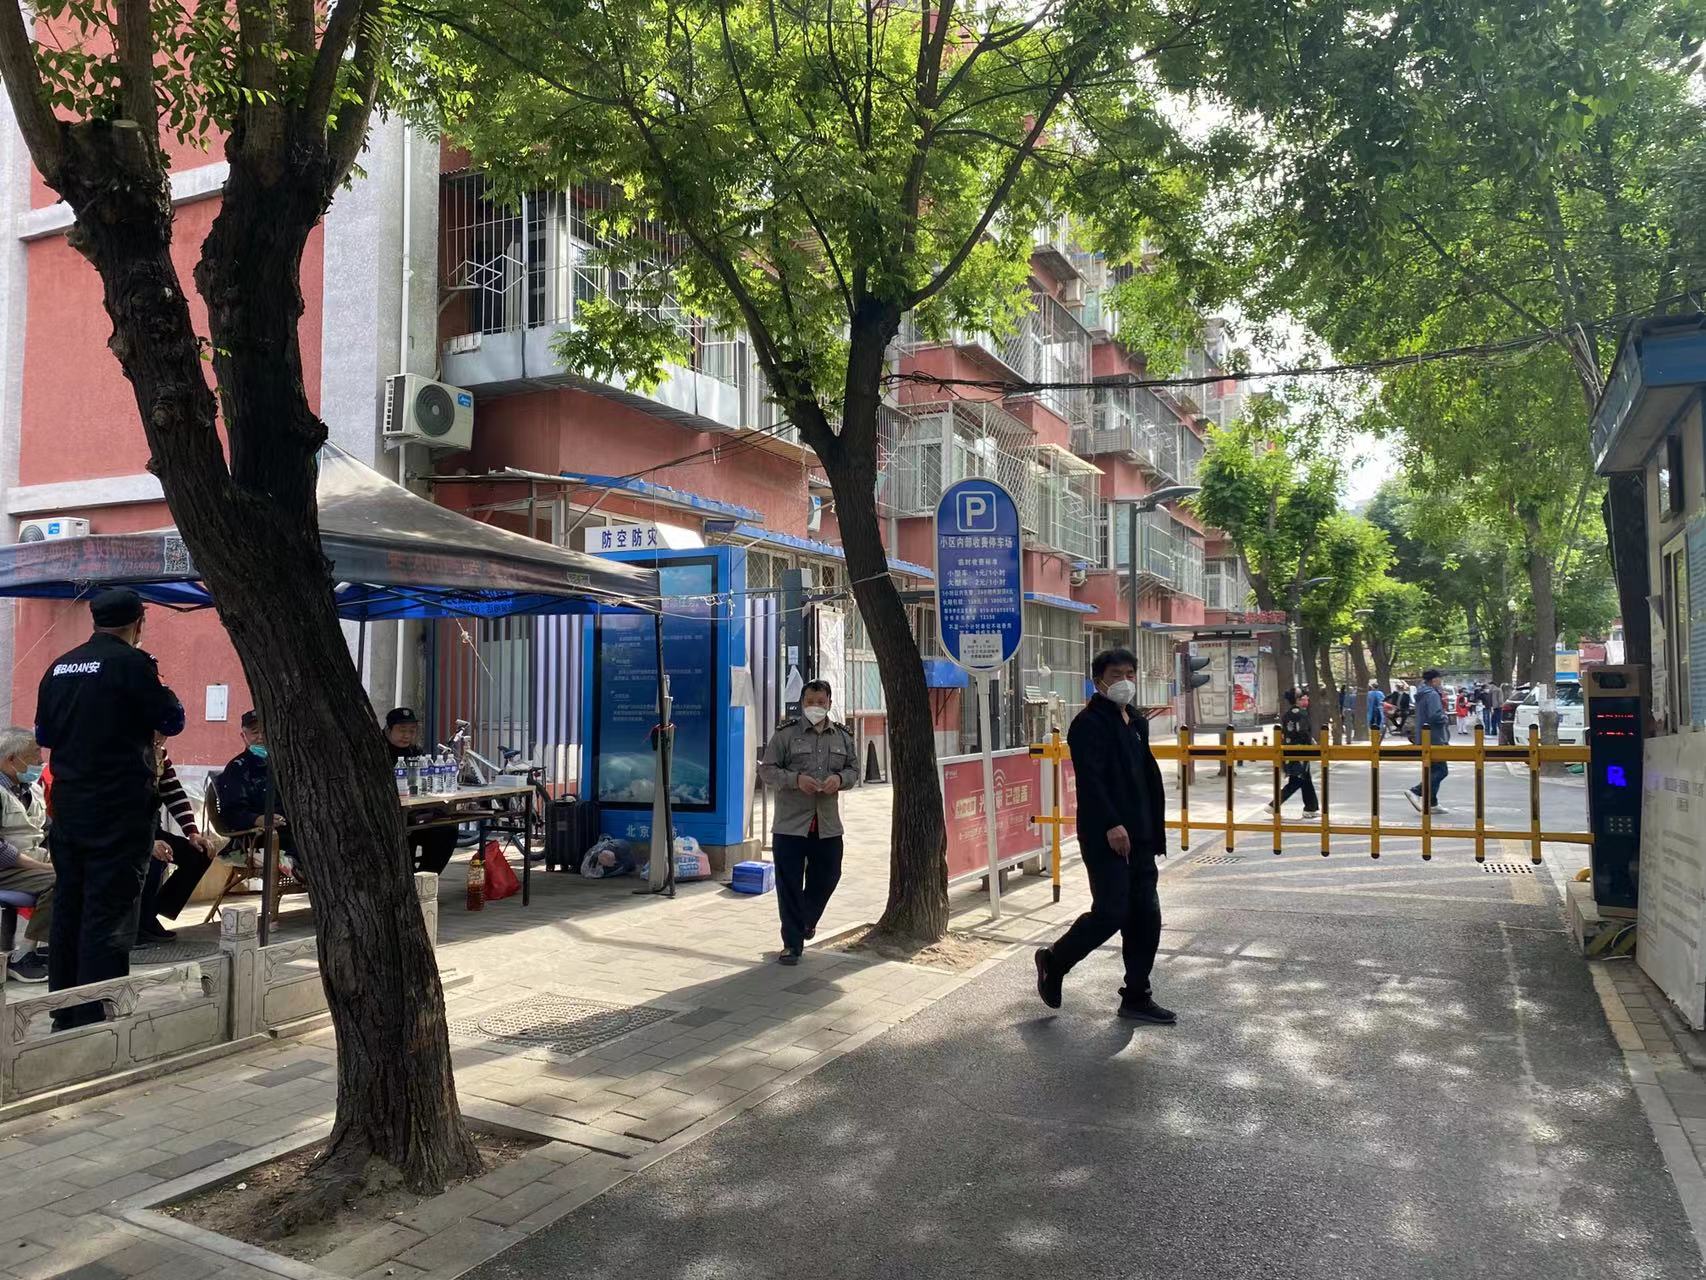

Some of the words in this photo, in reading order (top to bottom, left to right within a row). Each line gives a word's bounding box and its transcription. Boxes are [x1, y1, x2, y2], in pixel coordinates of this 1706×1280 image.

[965, 496, 987, 527] P
[601, 527, 658, 549] 防空防灾
[940, 536, 1013, 549] 小区内部收费停车场
